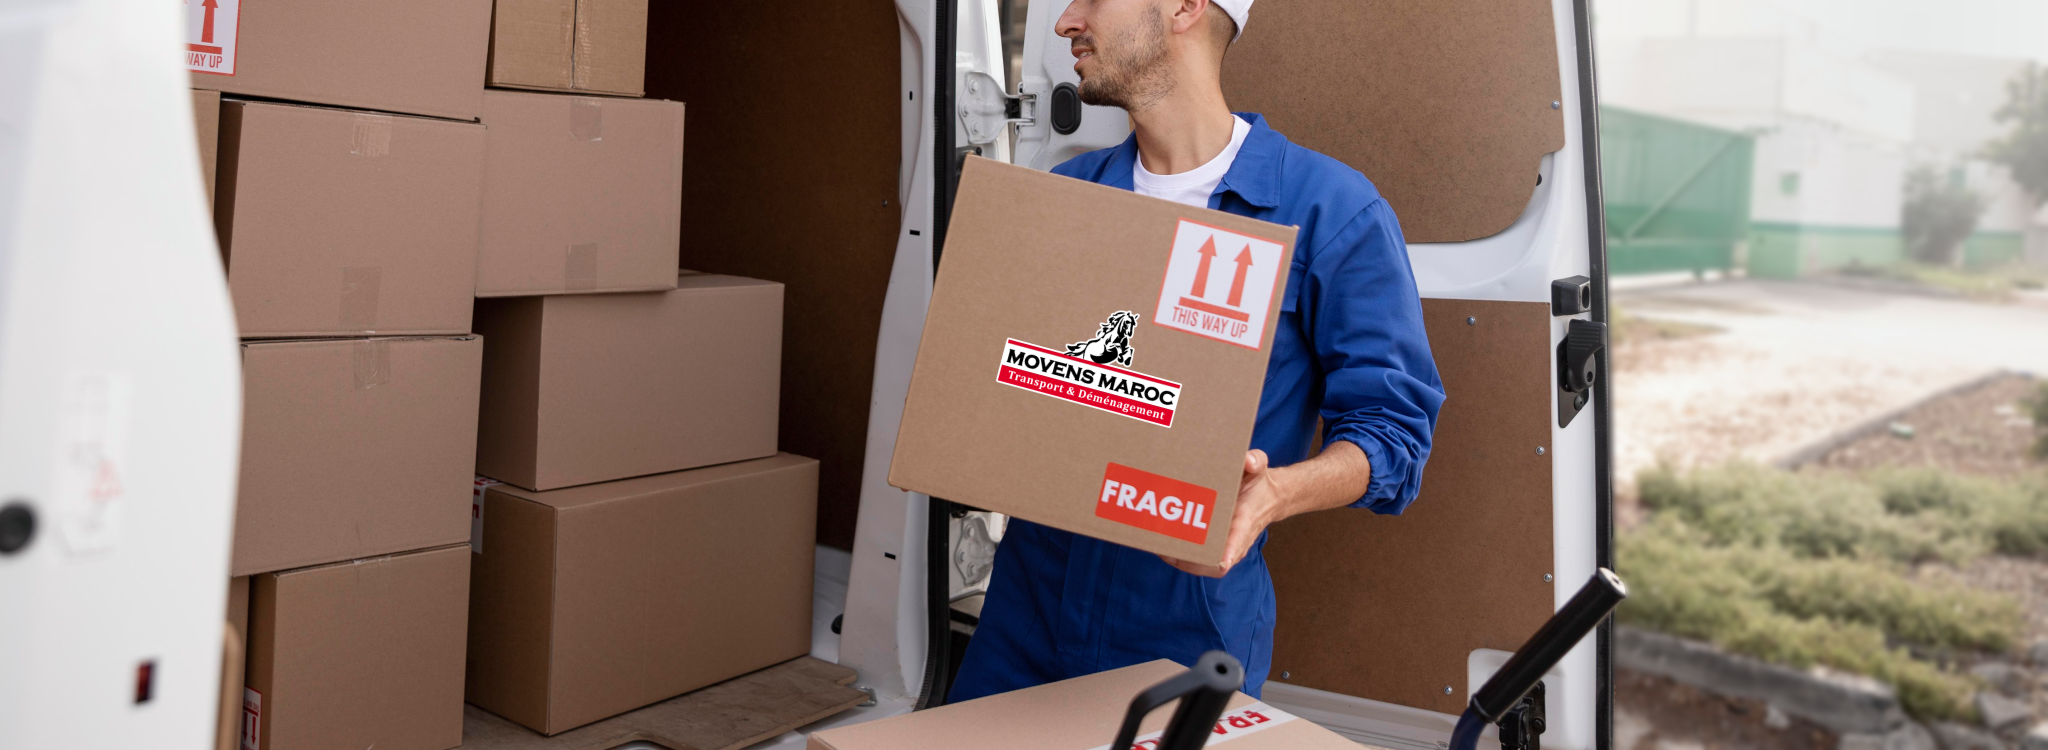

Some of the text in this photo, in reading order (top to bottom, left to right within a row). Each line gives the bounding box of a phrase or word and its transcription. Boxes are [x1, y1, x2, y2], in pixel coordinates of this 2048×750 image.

[209, 54, 223, 69] UP
[1172, 306, 1249, 339] THIS WAY UP
[1006, 349, 1176, 406] MOVENS MAROC
[1008, 370, 1165, 420] Transport & Déménagement
[1101, 478, 1207, 530] FRAGIL
